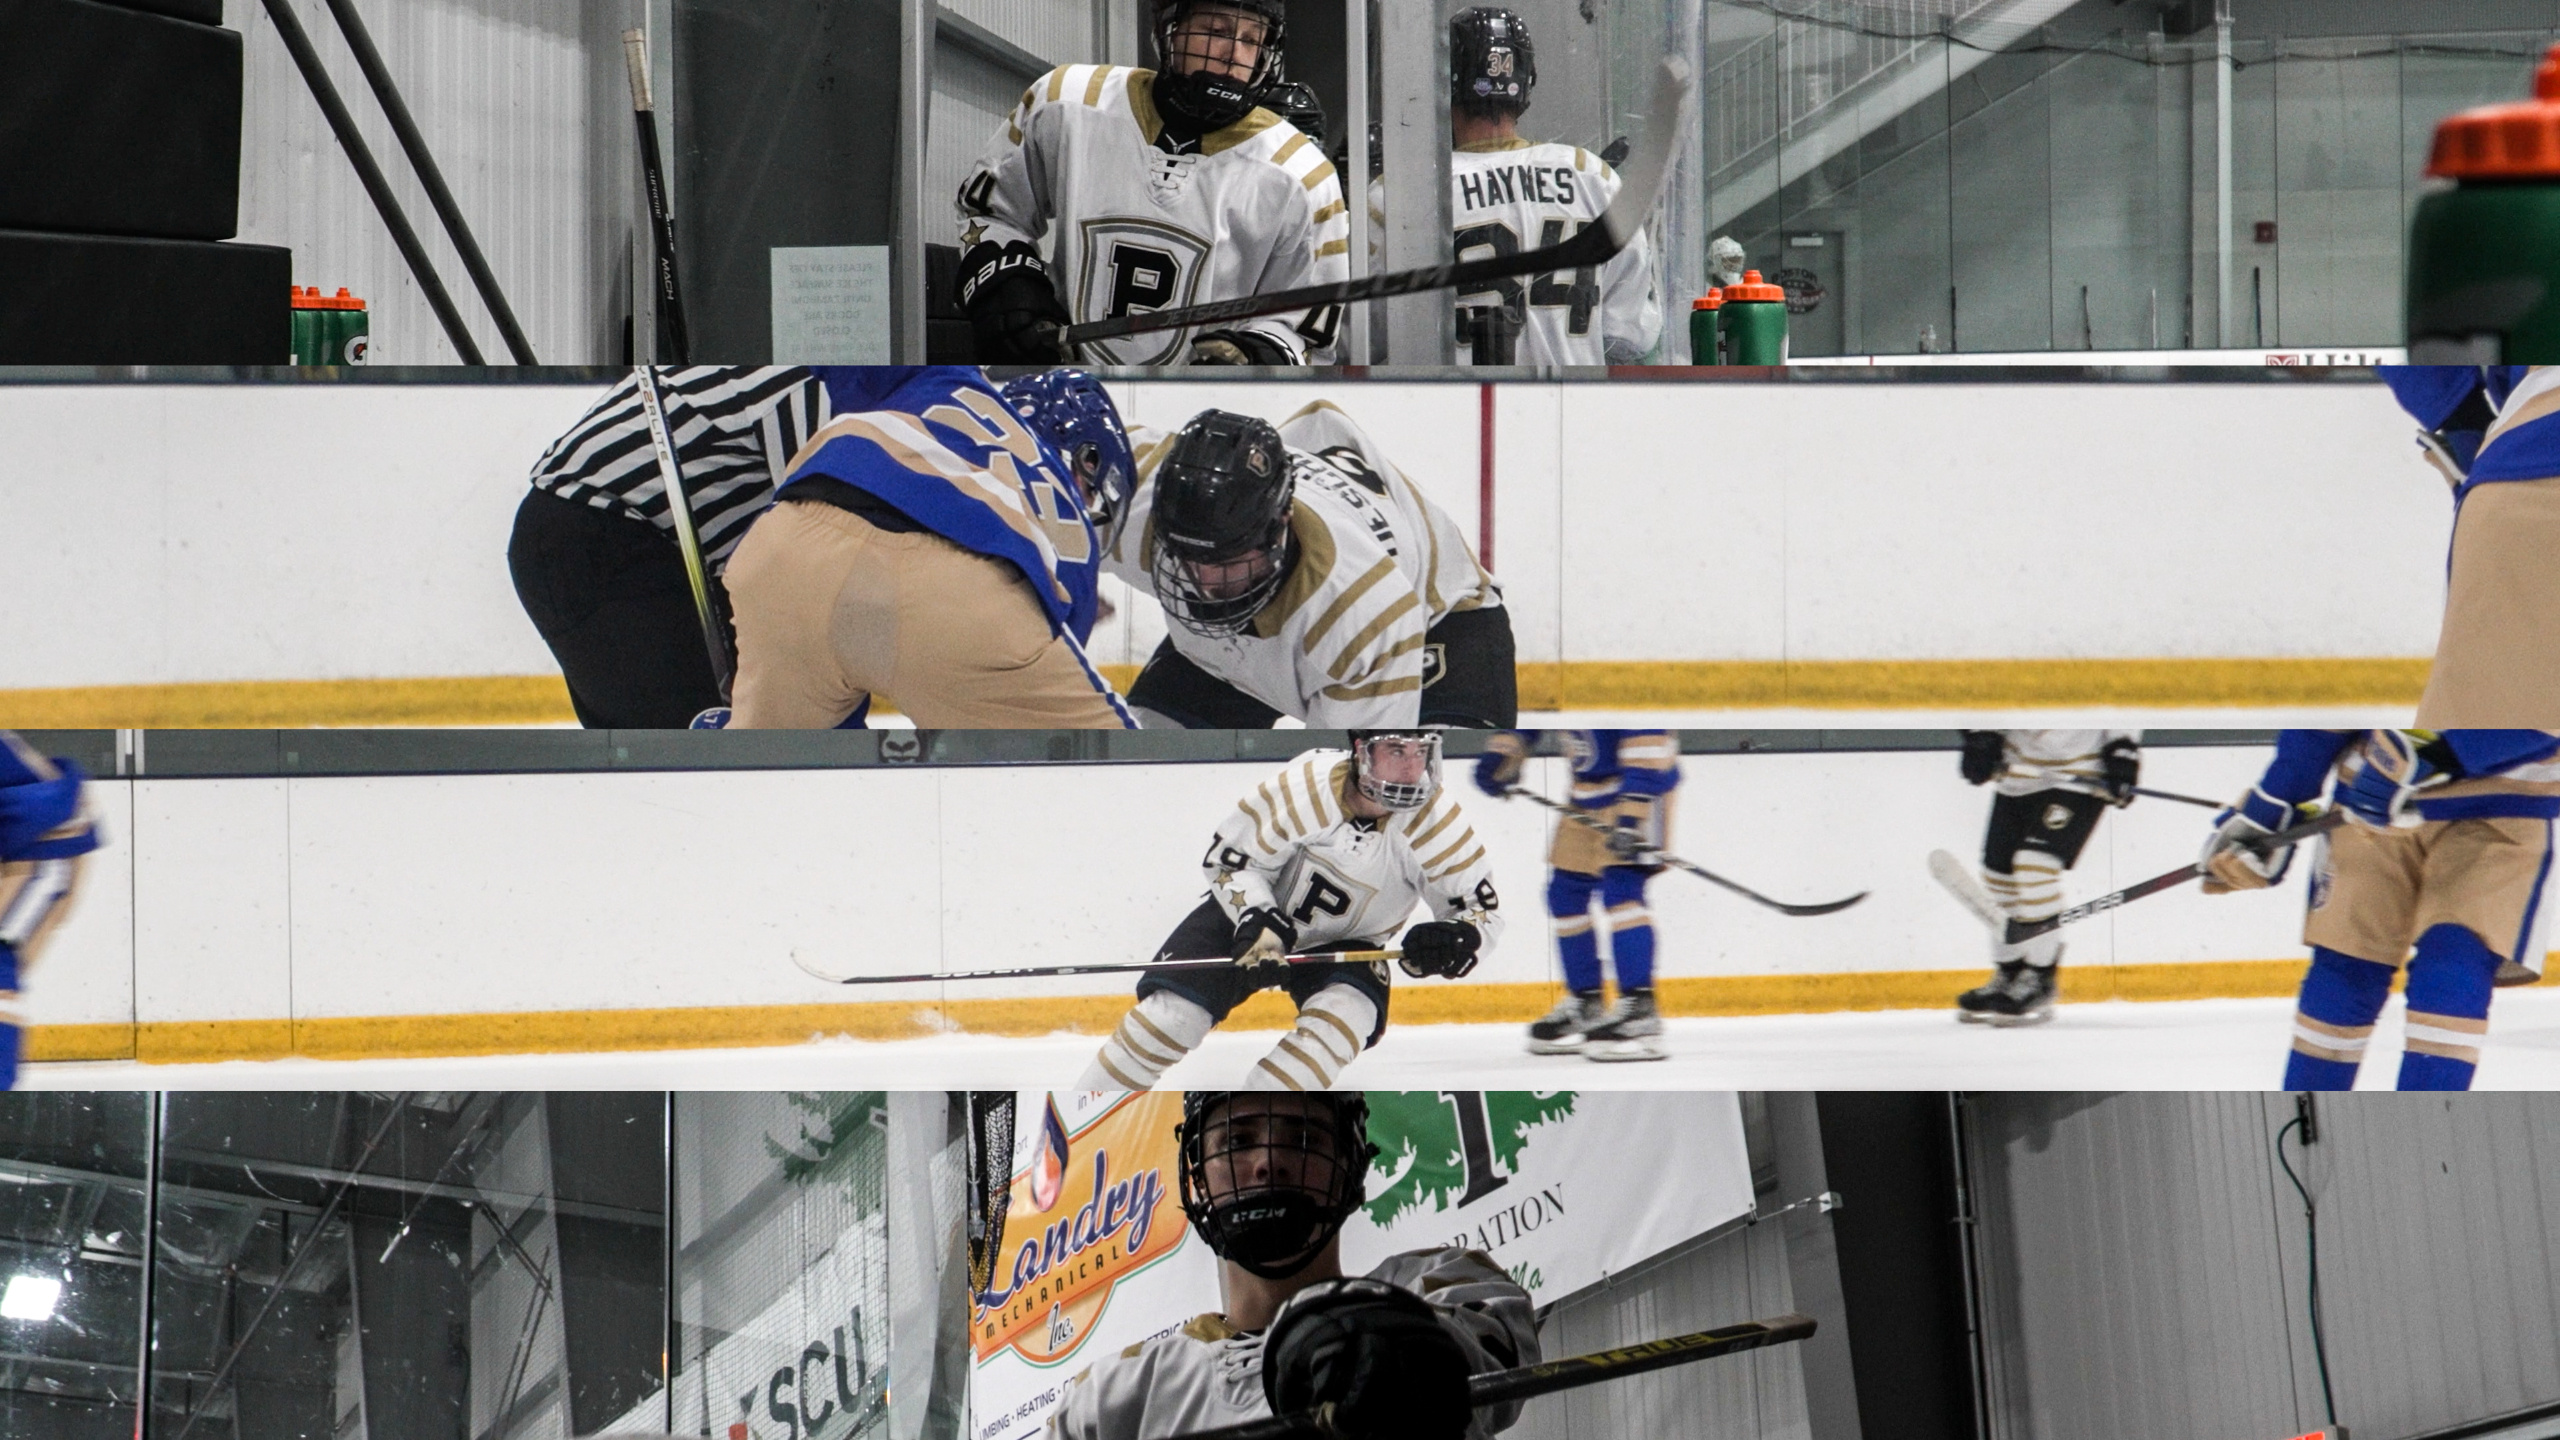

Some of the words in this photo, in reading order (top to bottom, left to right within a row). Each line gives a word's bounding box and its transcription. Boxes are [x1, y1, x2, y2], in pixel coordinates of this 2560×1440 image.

[1487, 52, 1514, 77] 34
[1206, 87, 1243, 102] CCM
[1460, 165, 1575, 211] HAYNES
[661, 257, 675, 300] MACH
[962, 254, 1048, 306] BAUE
[1103, 240, 1183, 342] P
[1160, 301, 1261, 327] JETSPEED
[1293, 870, 1352, 925] P
[986, 1246, 1119, 1340] MECHANICAL
[1048, 1302, 1075, 1352] Inc.
[1016, 1386, 1057, 1422] HEATING
